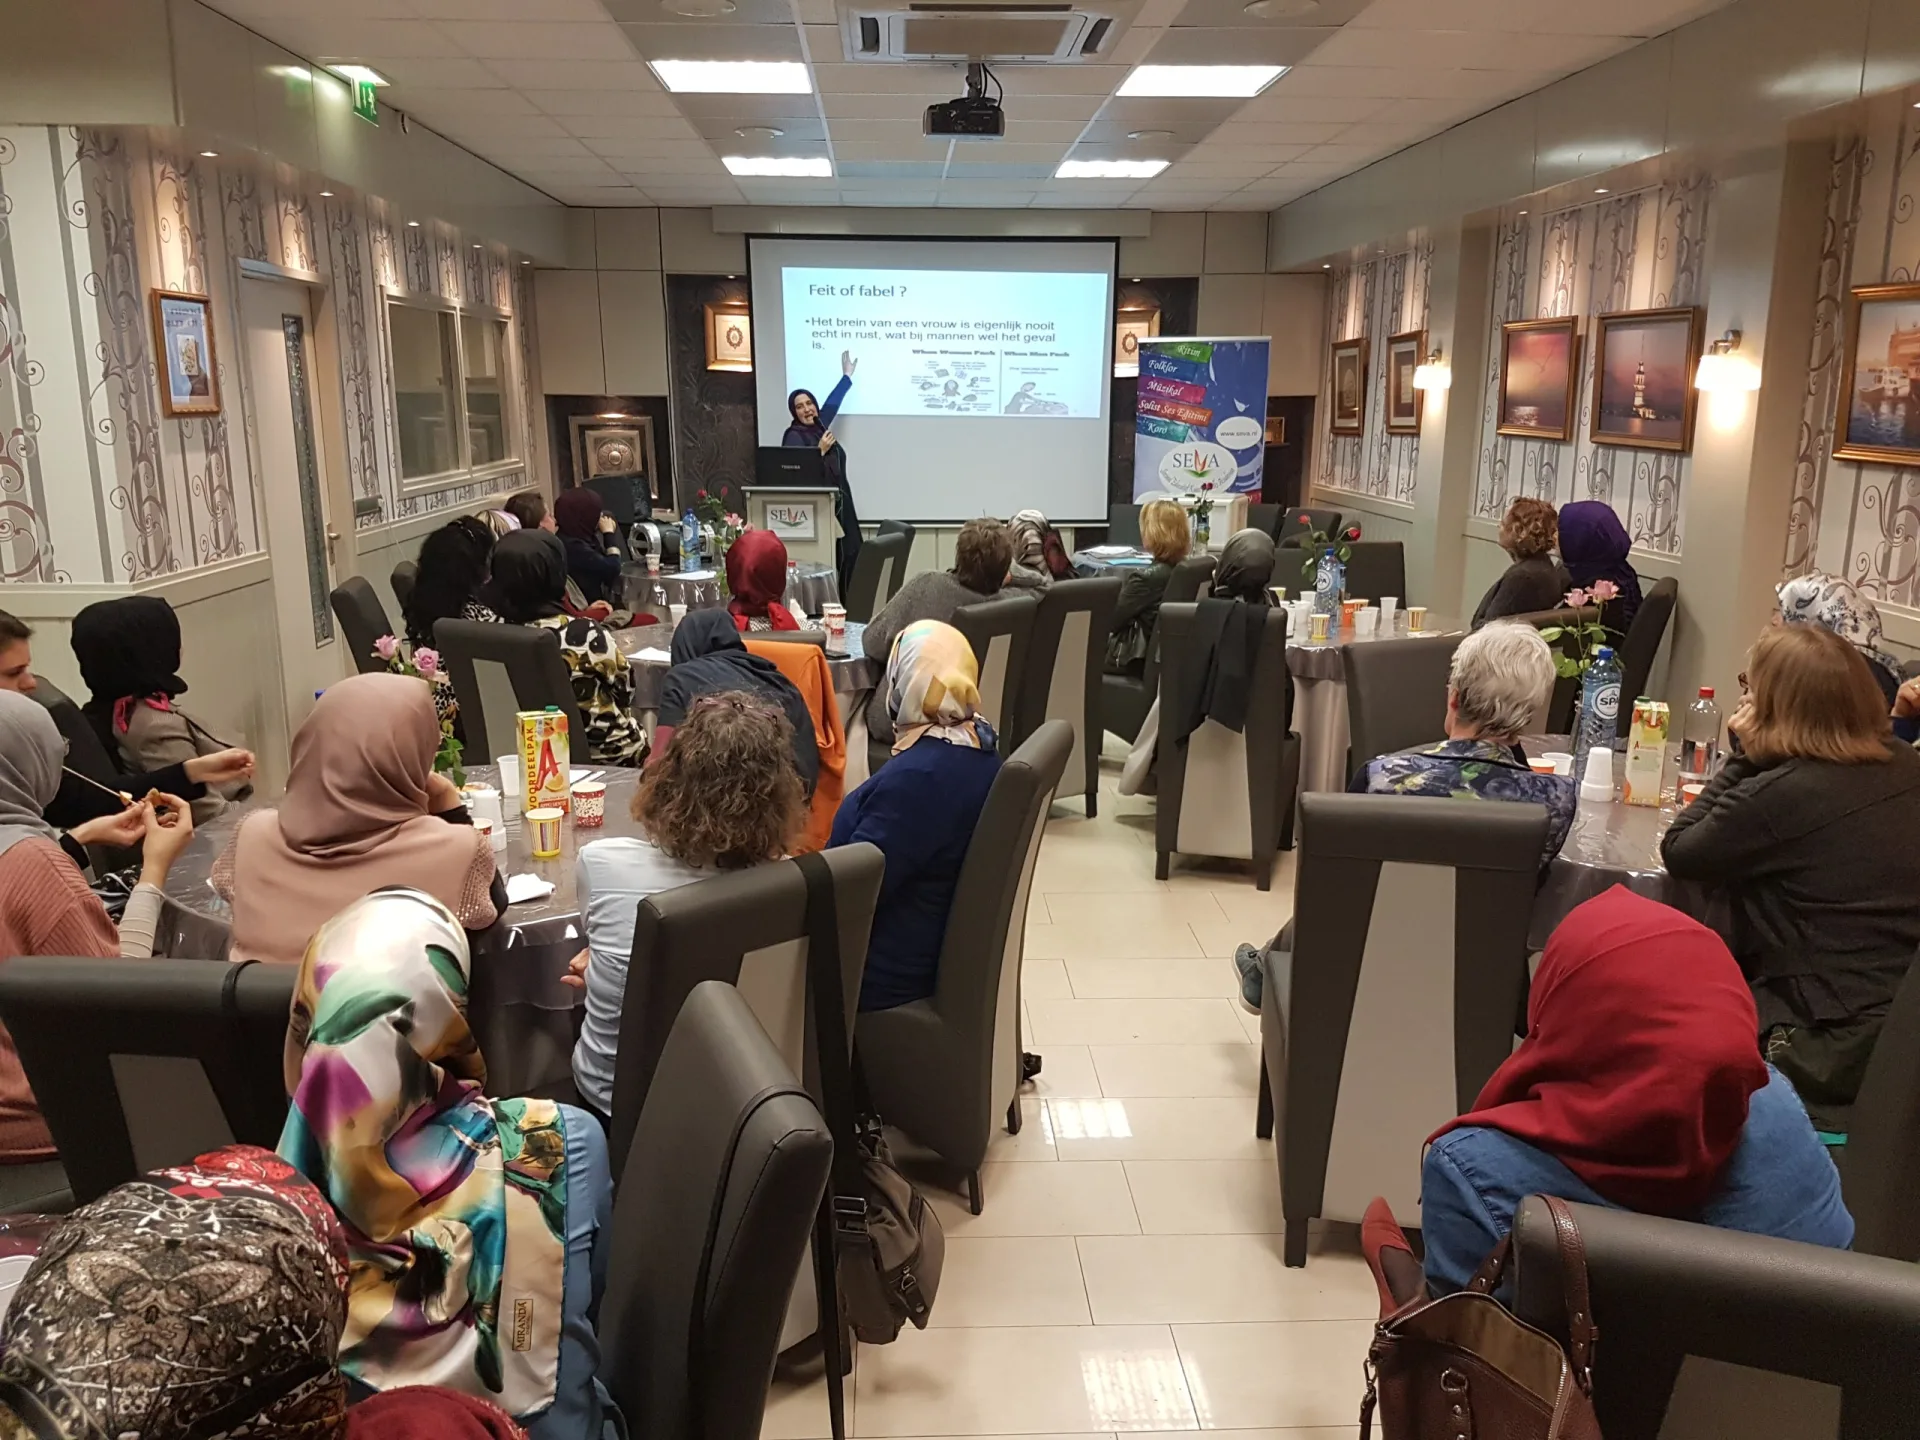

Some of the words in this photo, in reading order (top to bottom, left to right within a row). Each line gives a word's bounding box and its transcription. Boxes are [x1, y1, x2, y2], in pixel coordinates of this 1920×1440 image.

[809, 284, 836, 296] Feit
[840, 284, 855, 297] of
[859, 285, 895, 297] fabel
[899, 285, 907, 297] ?
[811, 317, 833, 327] Het
[836, 317, 866, 327] brein
[870, 319, 892, 328] van
[895, 320, 918, 328] een
[921, 320, 957, 329] vrouw
[960, 320, 970, 329] is
[974, 320, 1022, 331] eigenlijk
[1025, 321, 1055, 330] nooit
[811, 329, 838, 338] echt
[841, 330, 852, 339] in
[855, 330, 881, 340] rust,
[885, 331, 906, 339] wat
[909, 330, 923, 342] bij
[926, 333, 974, 341] mannen
[978, 332, 998, 341] wel
[1001, 332, 1020, 342] het
[1023, 333, 1056, 343] geval
[812, 340, 825, 350] is.
[1148, 359, 1179, 374] Folklor
[1146, 380, 1185, 397] Müzikal
[1161, 405, 1176, 415] Ses
[1172, 449, 1220, 471] SEVA
[770, 507, 808, 522] SEVA
[526, 727, 537, 811] VOORDEELPAK
[515, 1301, 527, 1348] MIRANDA
